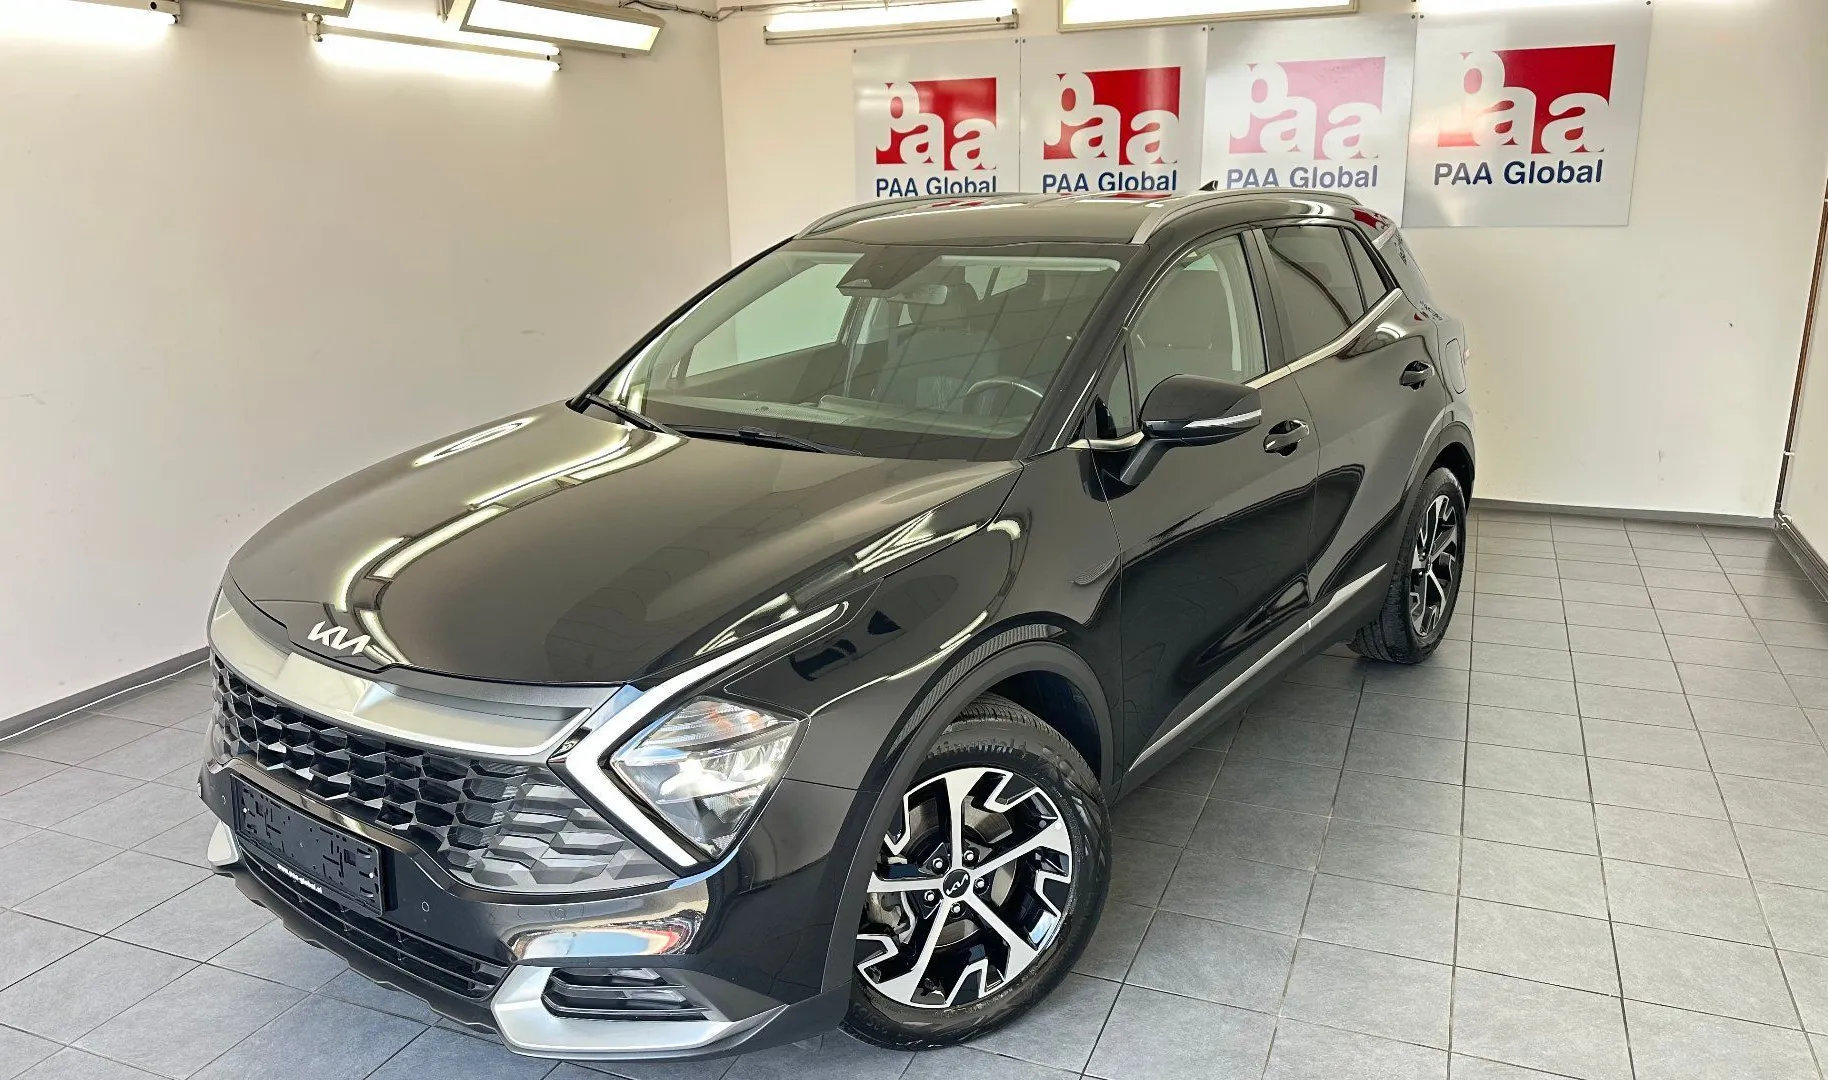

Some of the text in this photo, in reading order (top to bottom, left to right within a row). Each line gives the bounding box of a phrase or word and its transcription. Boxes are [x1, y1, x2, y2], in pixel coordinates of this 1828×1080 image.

[1042, 170, 1177, 194] PAA Global
[1226, 165, 1378, 189] PAA Global
[1433, 159, 1603, 186] PAA Global
[876, 176, 997, 198] PAA Global
[308, 621, 371, 655] KIA
